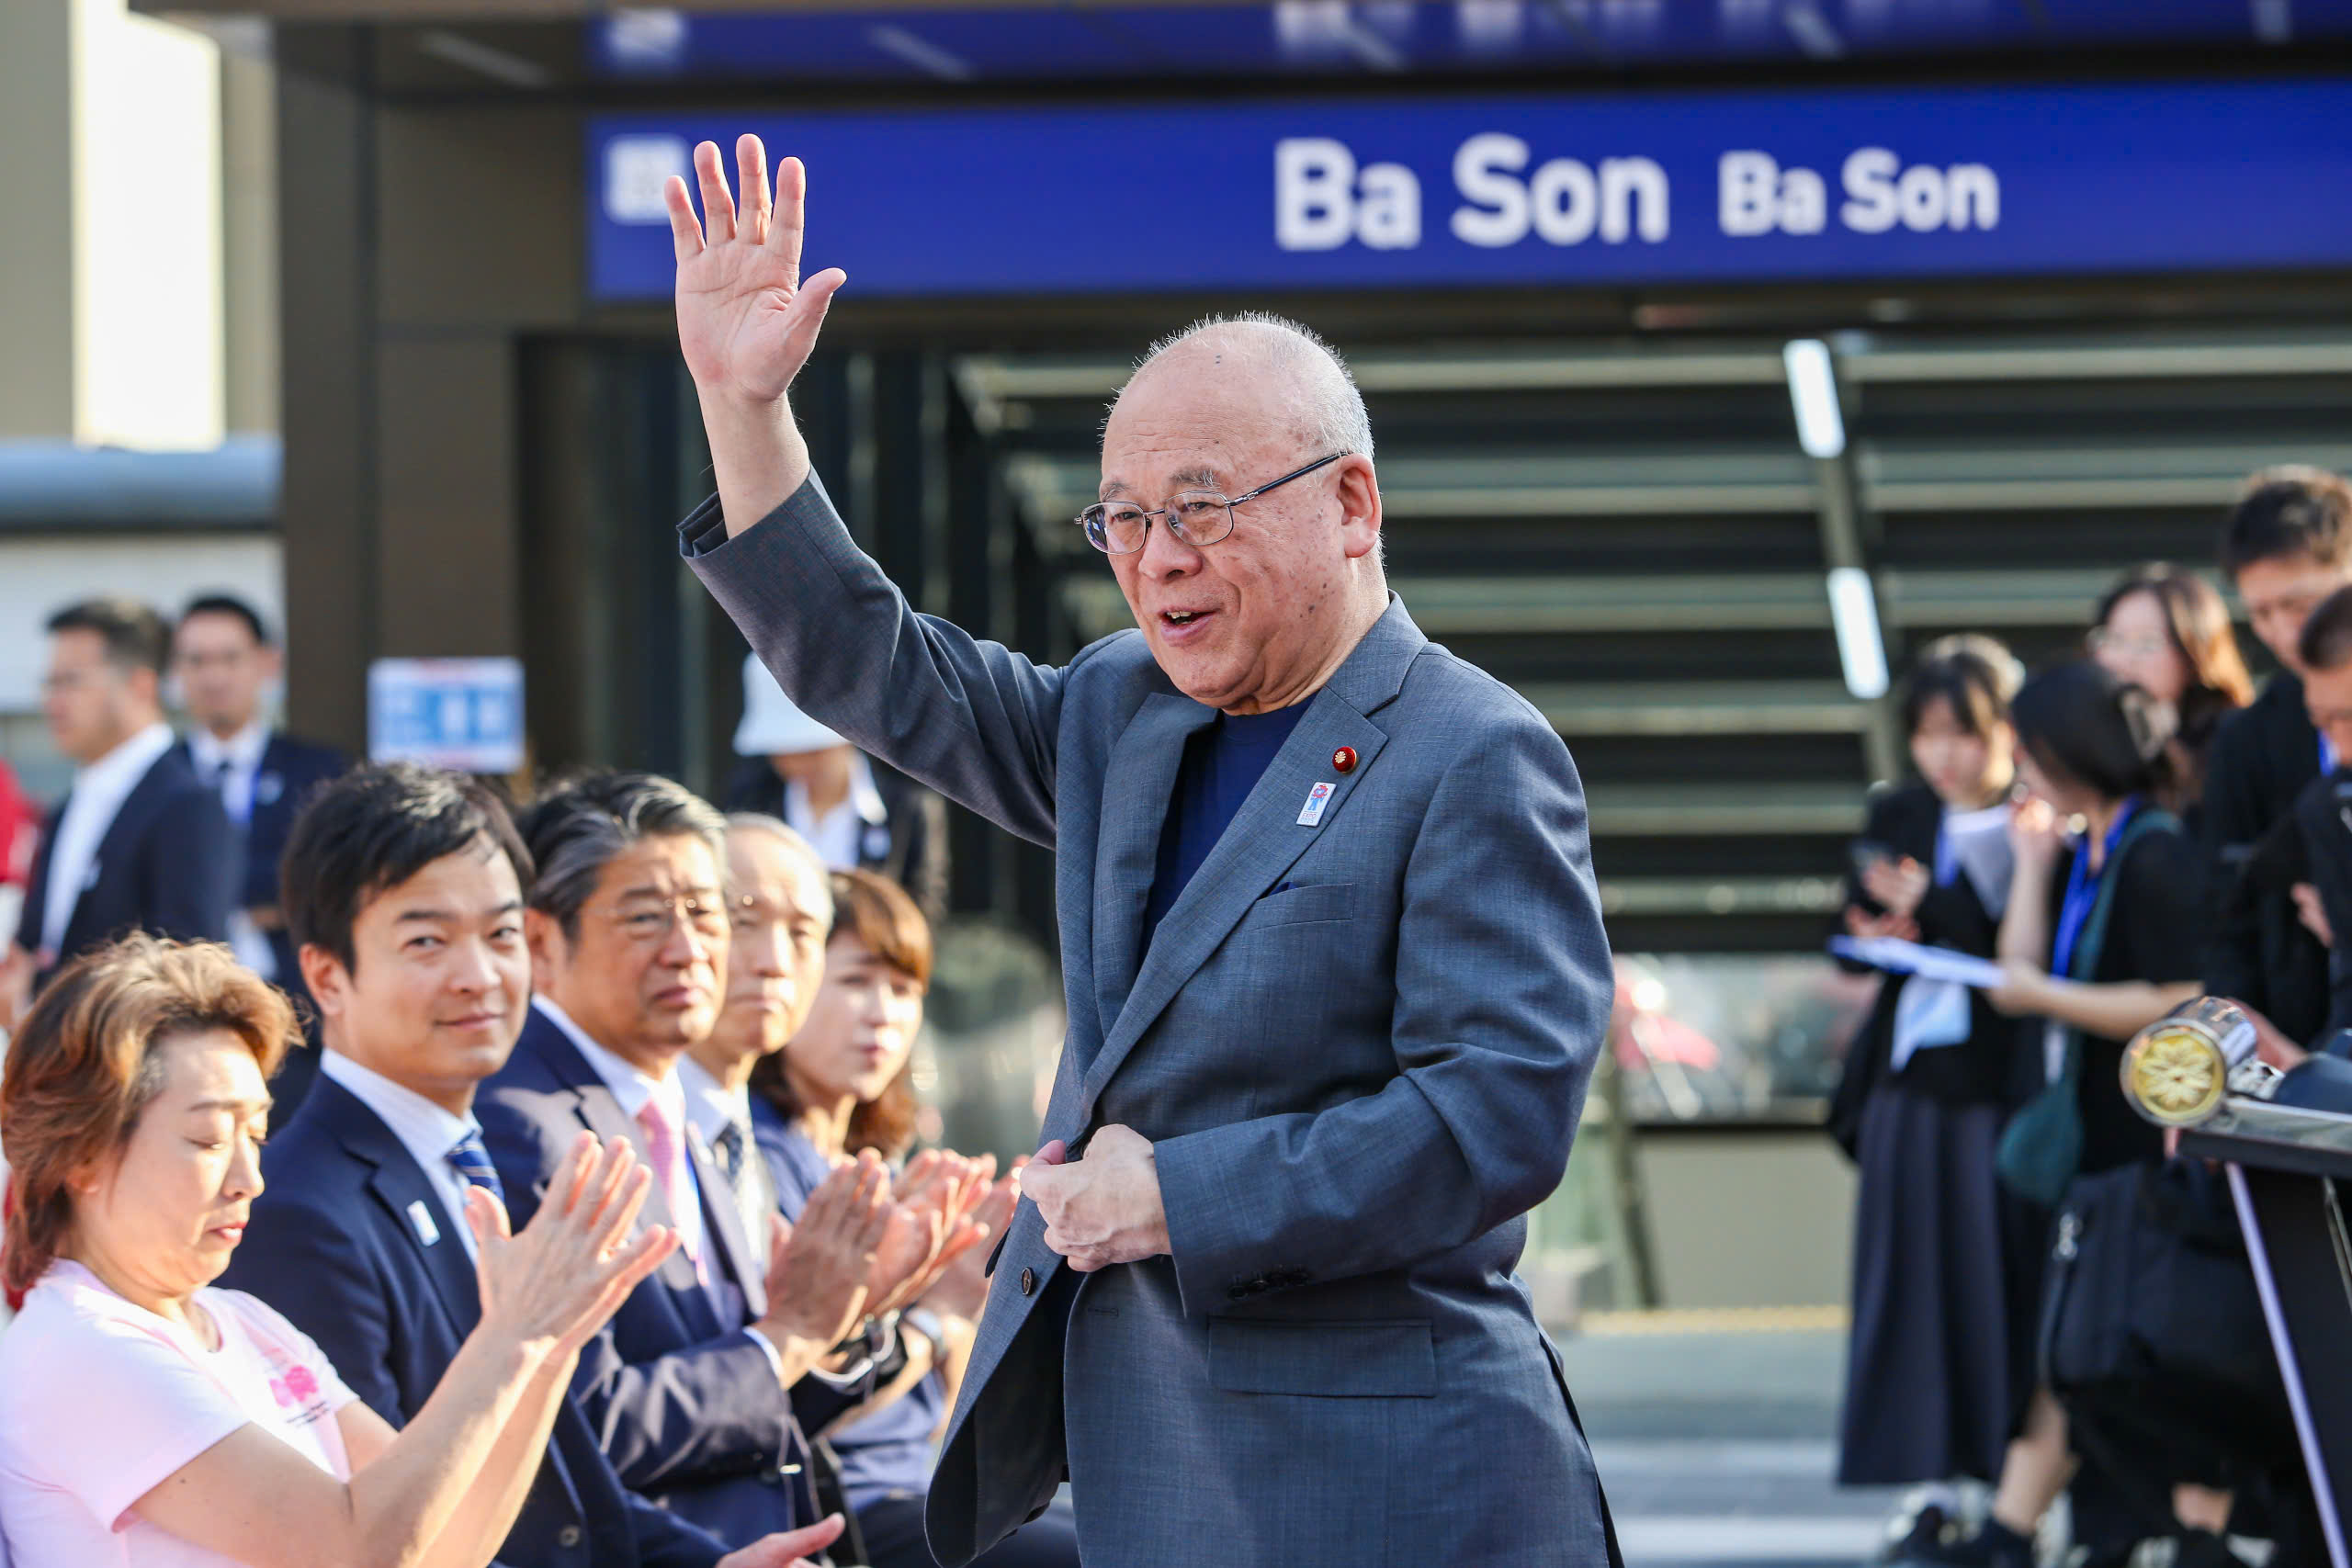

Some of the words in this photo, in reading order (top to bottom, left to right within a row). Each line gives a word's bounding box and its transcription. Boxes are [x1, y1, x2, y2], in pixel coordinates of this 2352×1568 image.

[1275, 139, 1421, 250] Ba
[1451, 133, 1669, 247] Son
[1718, 150, 1826, 236] Ba
[1841, 147, 1999, 232] Son
